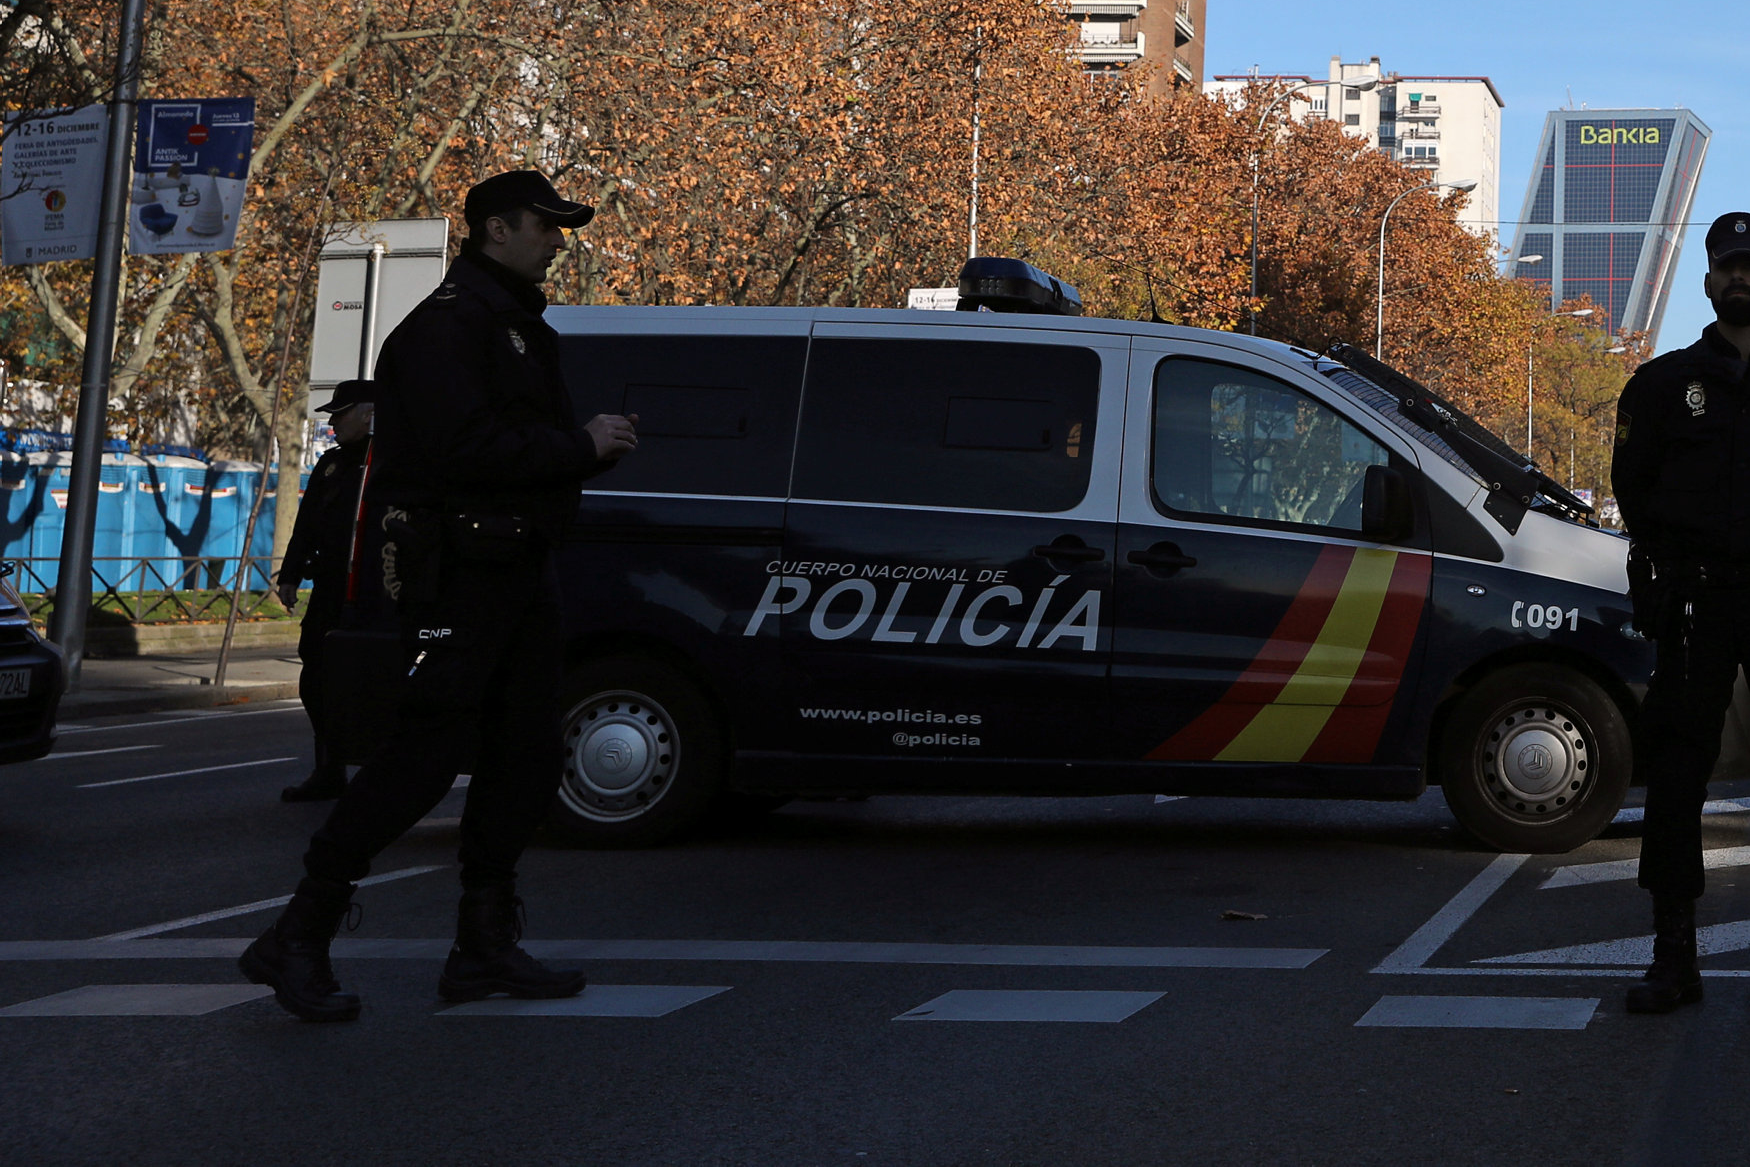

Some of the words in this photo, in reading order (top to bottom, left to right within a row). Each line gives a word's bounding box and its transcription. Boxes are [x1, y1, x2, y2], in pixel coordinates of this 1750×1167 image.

[57, 122, 100, 134] DICIEMBRE
[1581, 125, 1660, 144] Bankia
[39, 245, 77, 256] MADRID
[766, 560, 856, 577] CUERPO
[860, 564, 969, 582] NACIONAL
[976, 570, 1008, 584] DE
[743, 574, 1101, 652] POLICÍA
[1527, 604, 1579, 631] 091
[418, 628, 453, 640] CNP
[800, 708, 982, 725] www.policia.es
[892, 732, 981, 747] @policia
